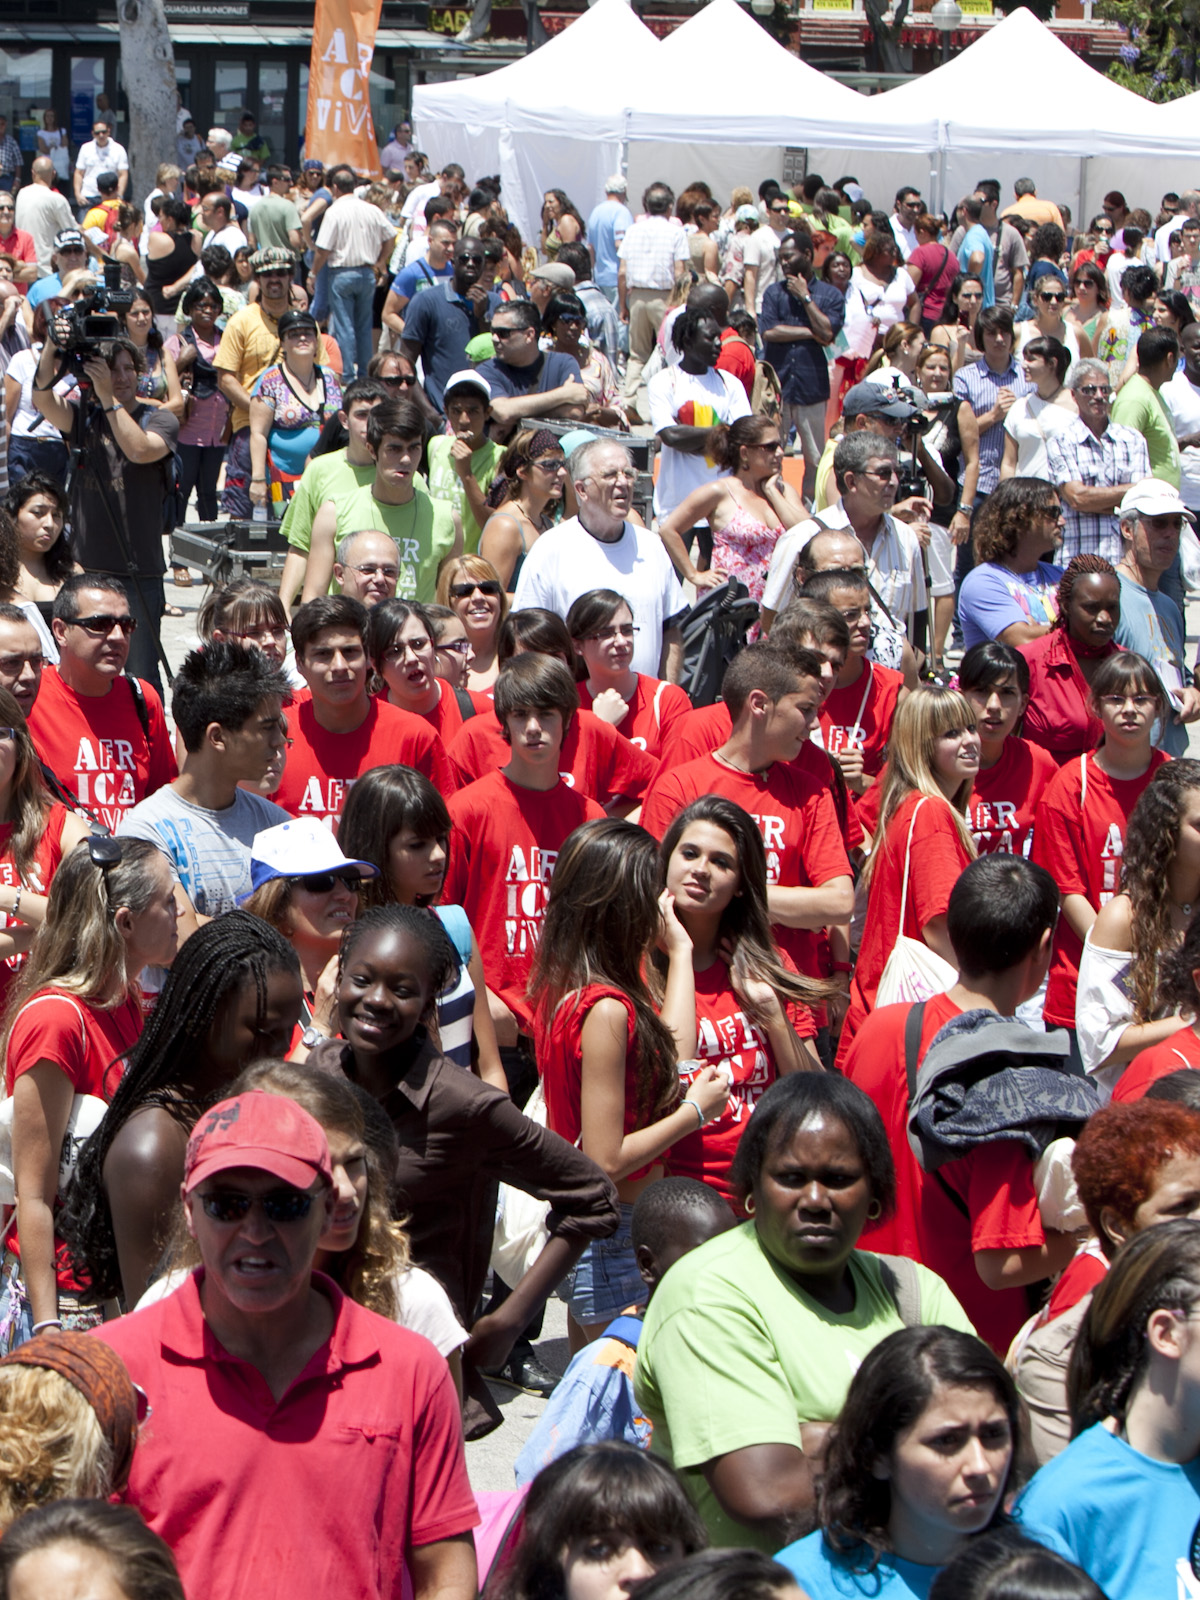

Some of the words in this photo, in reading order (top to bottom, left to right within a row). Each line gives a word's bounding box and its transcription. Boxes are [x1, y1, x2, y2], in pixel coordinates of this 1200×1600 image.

[202, 6, 248, 15] MUNICIPALES
[74, 737, 136, 771] AFR
[74, 772, 136, 805] ICA
[298, 776, 357, 811] AF
[505, 845, 559, 882] AFR
[696, 1012, 768, 1058] AFR
